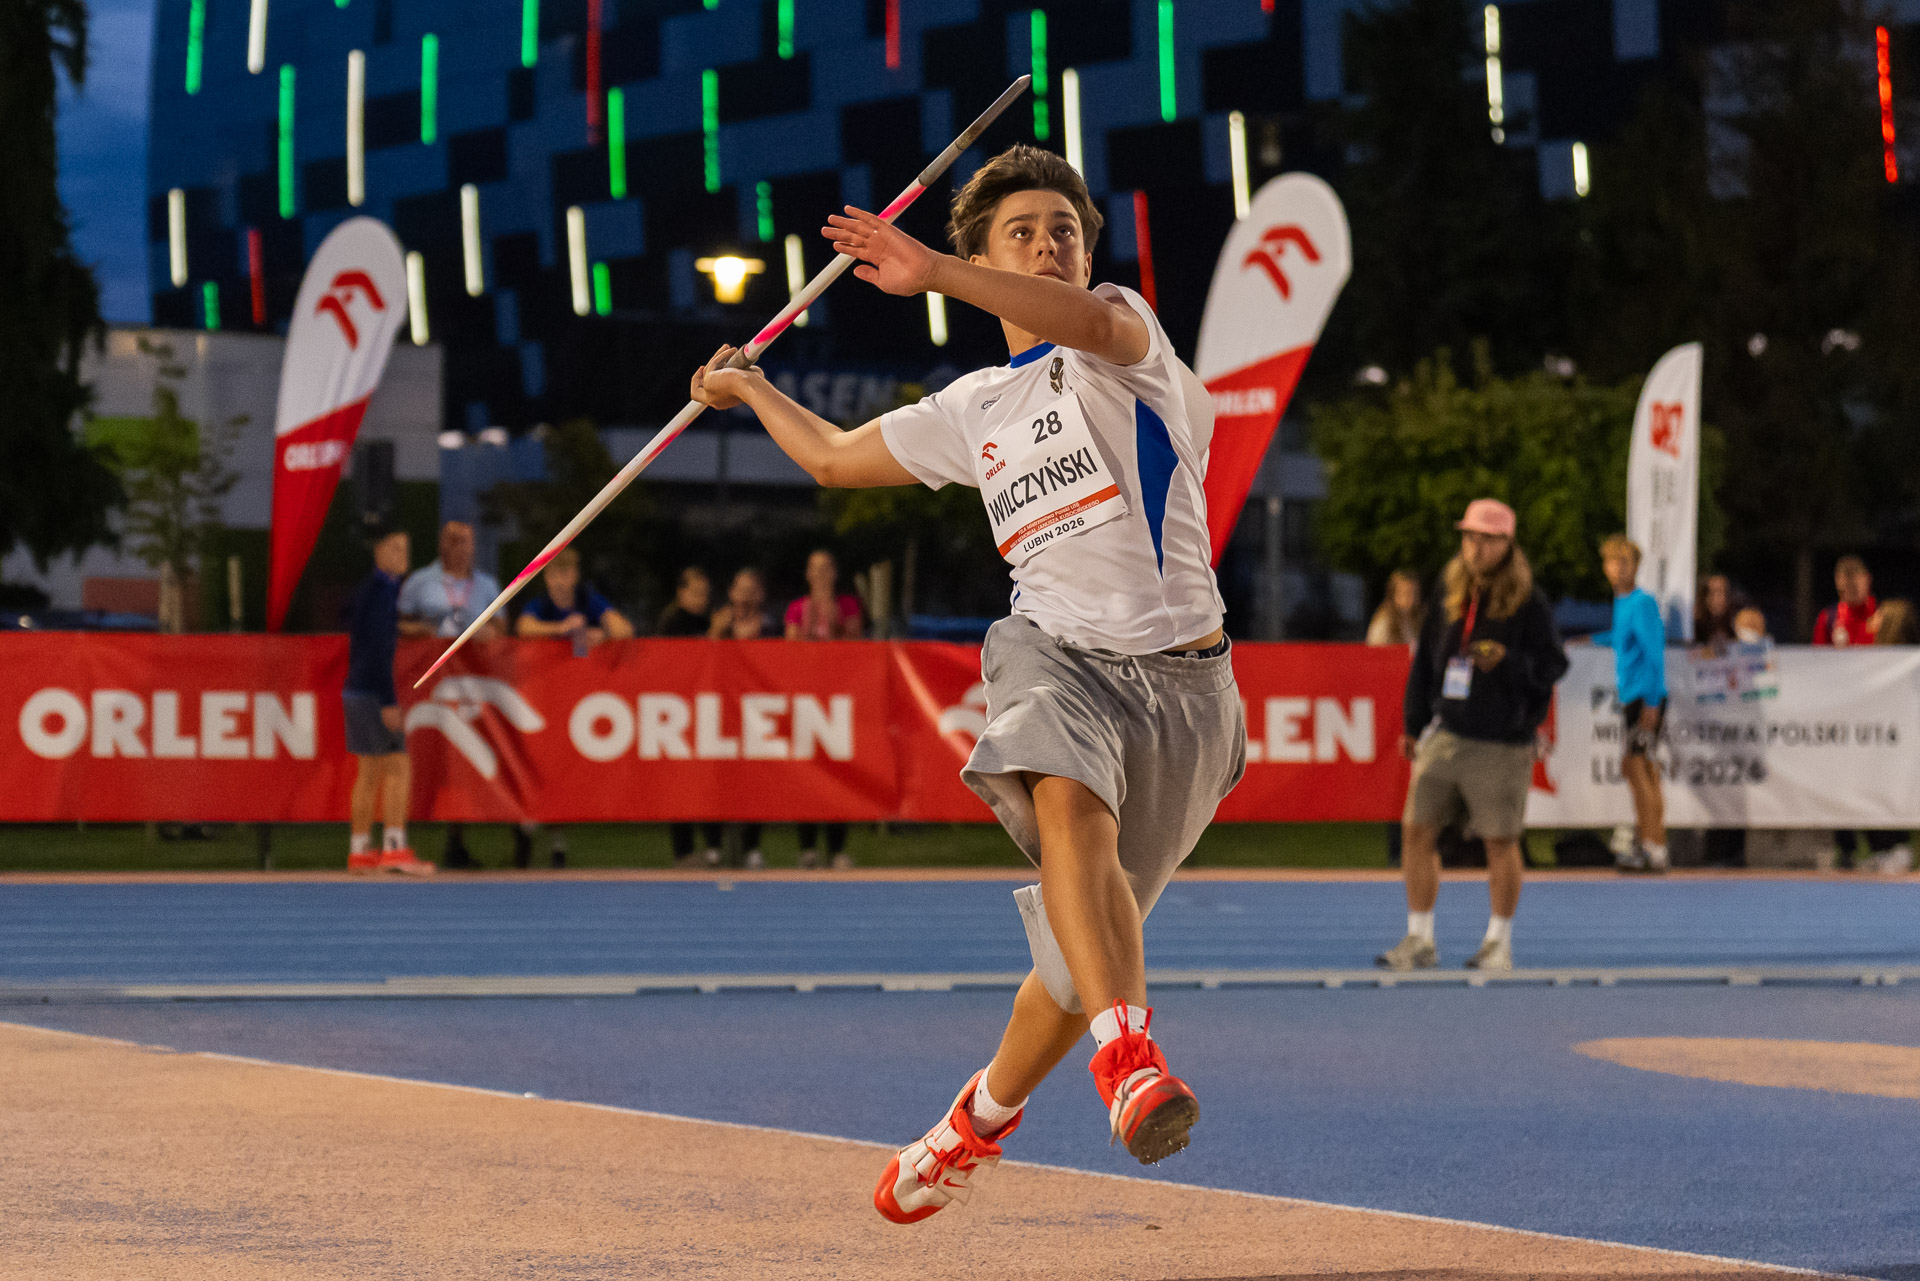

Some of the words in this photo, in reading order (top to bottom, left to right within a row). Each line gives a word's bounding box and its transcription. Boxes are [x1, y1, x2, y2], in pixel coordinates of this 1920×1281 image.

[1031, 411, 1063, 444] 28
[985, 459, 1007, 481] ORLEN
[988, 446, 1098, 527] WILCZYŃSKI
[1023, 530, 1054, 553] LUBIN
[1054, 517, 1085, 537] 2026
[19, 687, 317, 760] ORLEN
[567, 690, 854, 763] ORLEN
[1767, 721, 1849, 746] POLSKI
[1855, 720, 1899, 746] U16
[1688, 755, 1768, 786] 2026
